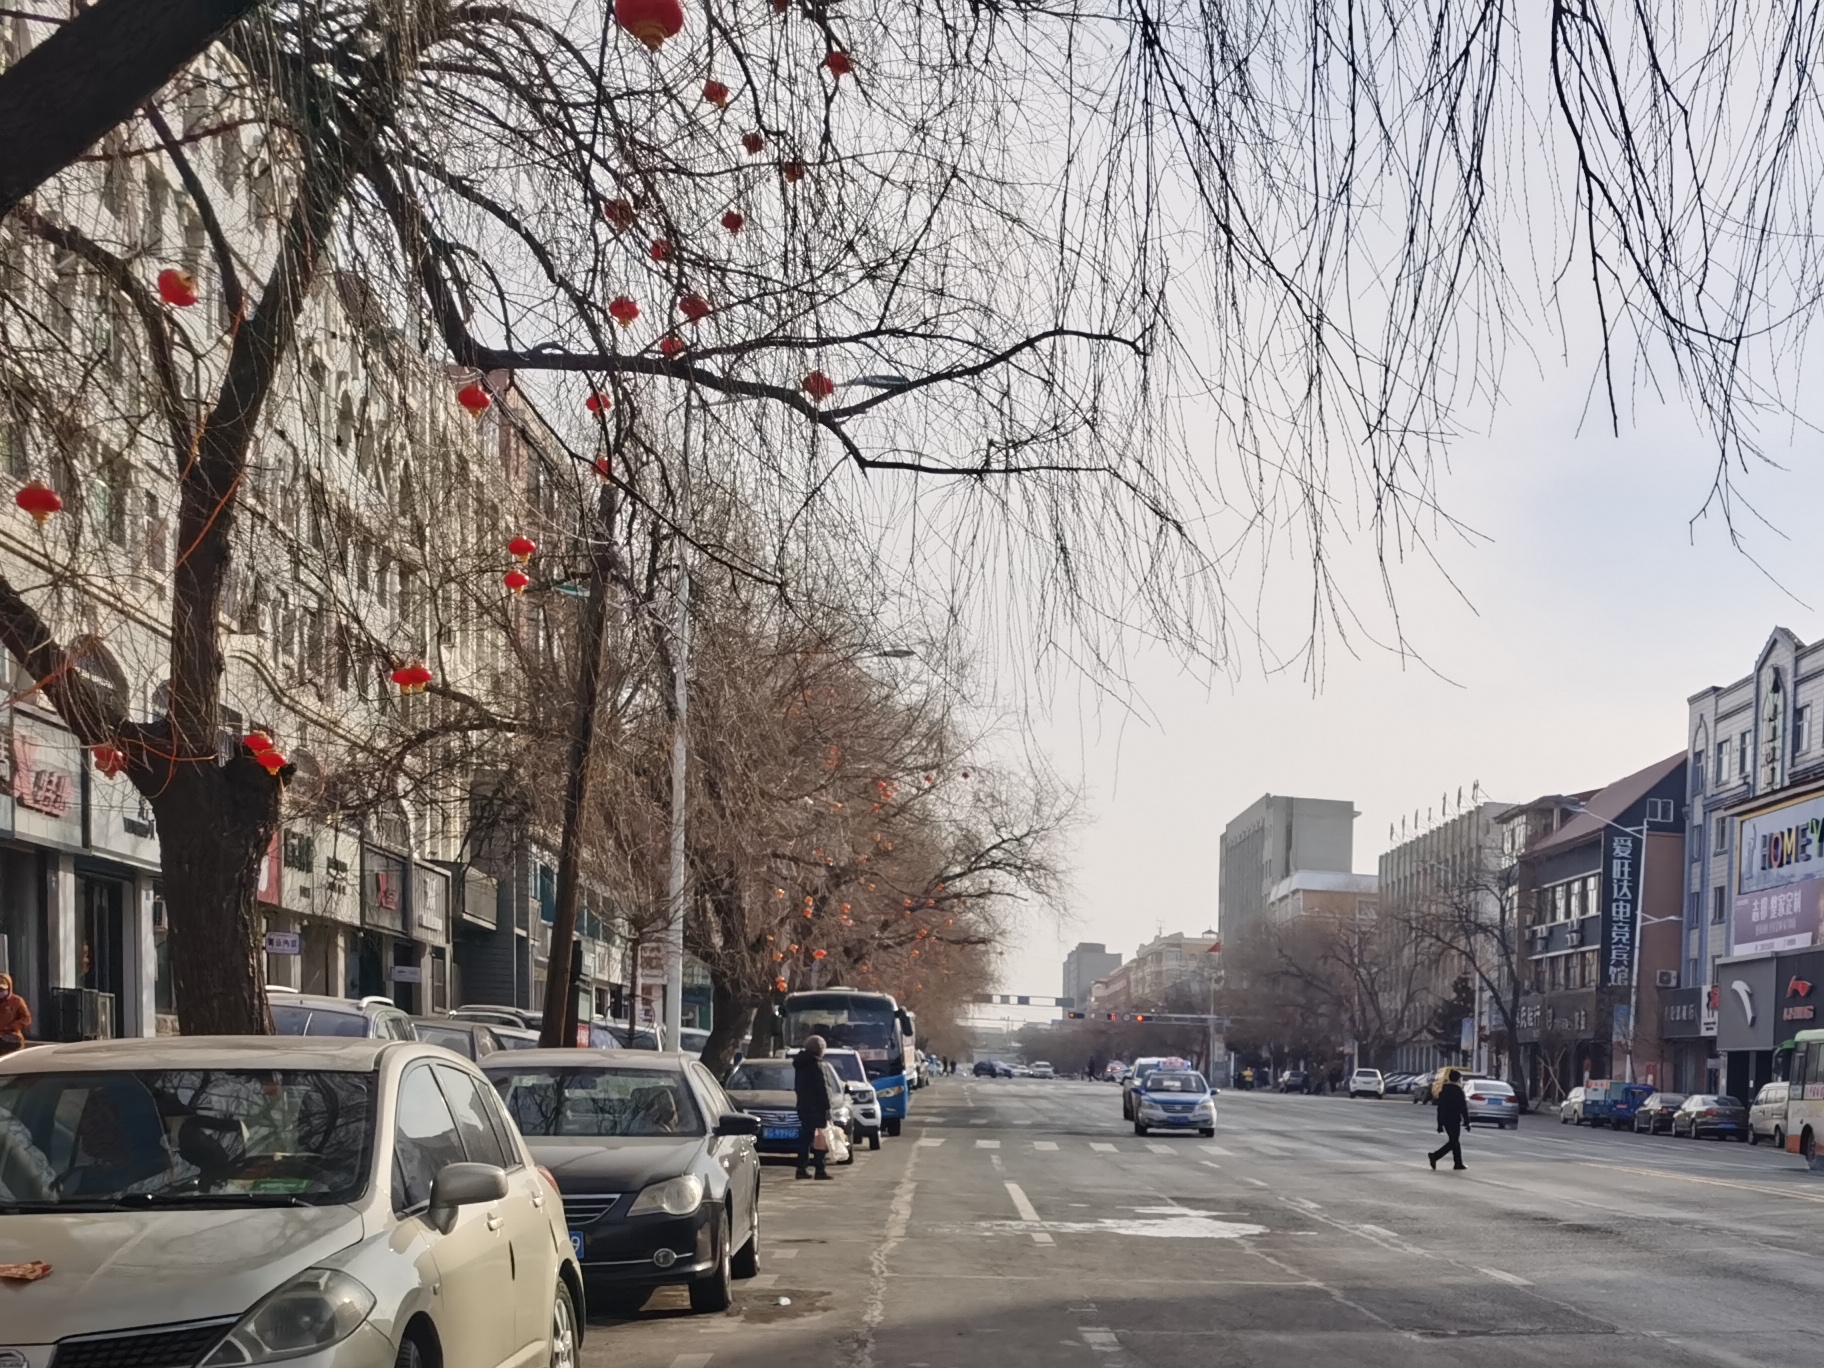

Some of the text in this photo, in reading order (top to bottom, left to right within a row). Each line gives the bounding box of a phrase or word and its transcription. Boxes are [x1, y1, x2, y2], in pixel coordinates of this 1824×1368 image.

[1607, 835, 1634, 987] 爱旺达电竞宾馆
